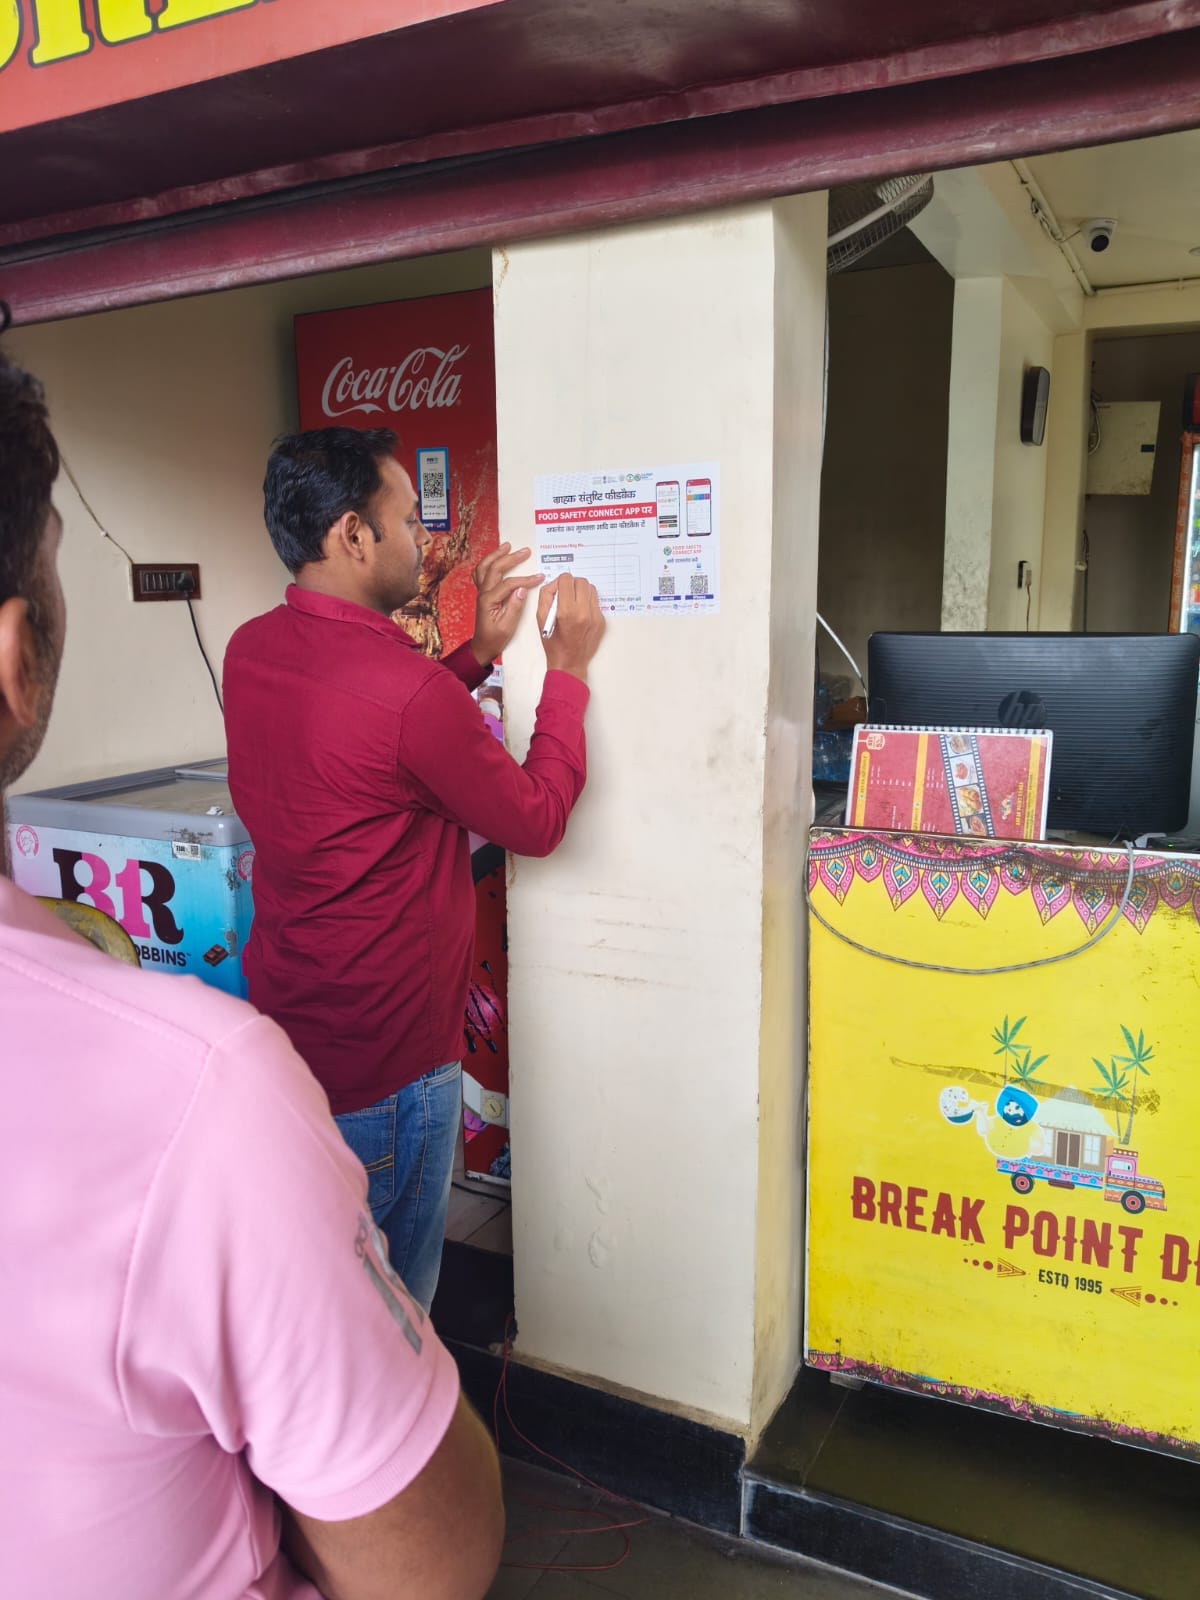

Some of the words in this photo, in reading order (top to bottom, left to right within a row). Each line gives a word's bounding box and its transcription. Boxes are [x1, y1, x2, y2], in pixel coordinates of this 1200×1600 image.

[322, 344, 471, 417] Coca-Cola
[552, 494, 576, 504] ग्राहक
[579, 490, 603, 504] संतुष्टि
[605, 488, 637, 500] फीडबैक
[538, 513, 559, 521] FOOD
[560, 511, 587, 519] SAFETY
[588, 508, 623, 518] CONNECT
[625, 507, 640, 515] APP
[851, 1176, 985, 1244] BREAK
[1003, 1204, 1143, 1273] POINT
[1074, 1276, 1102, 1294] 1995
